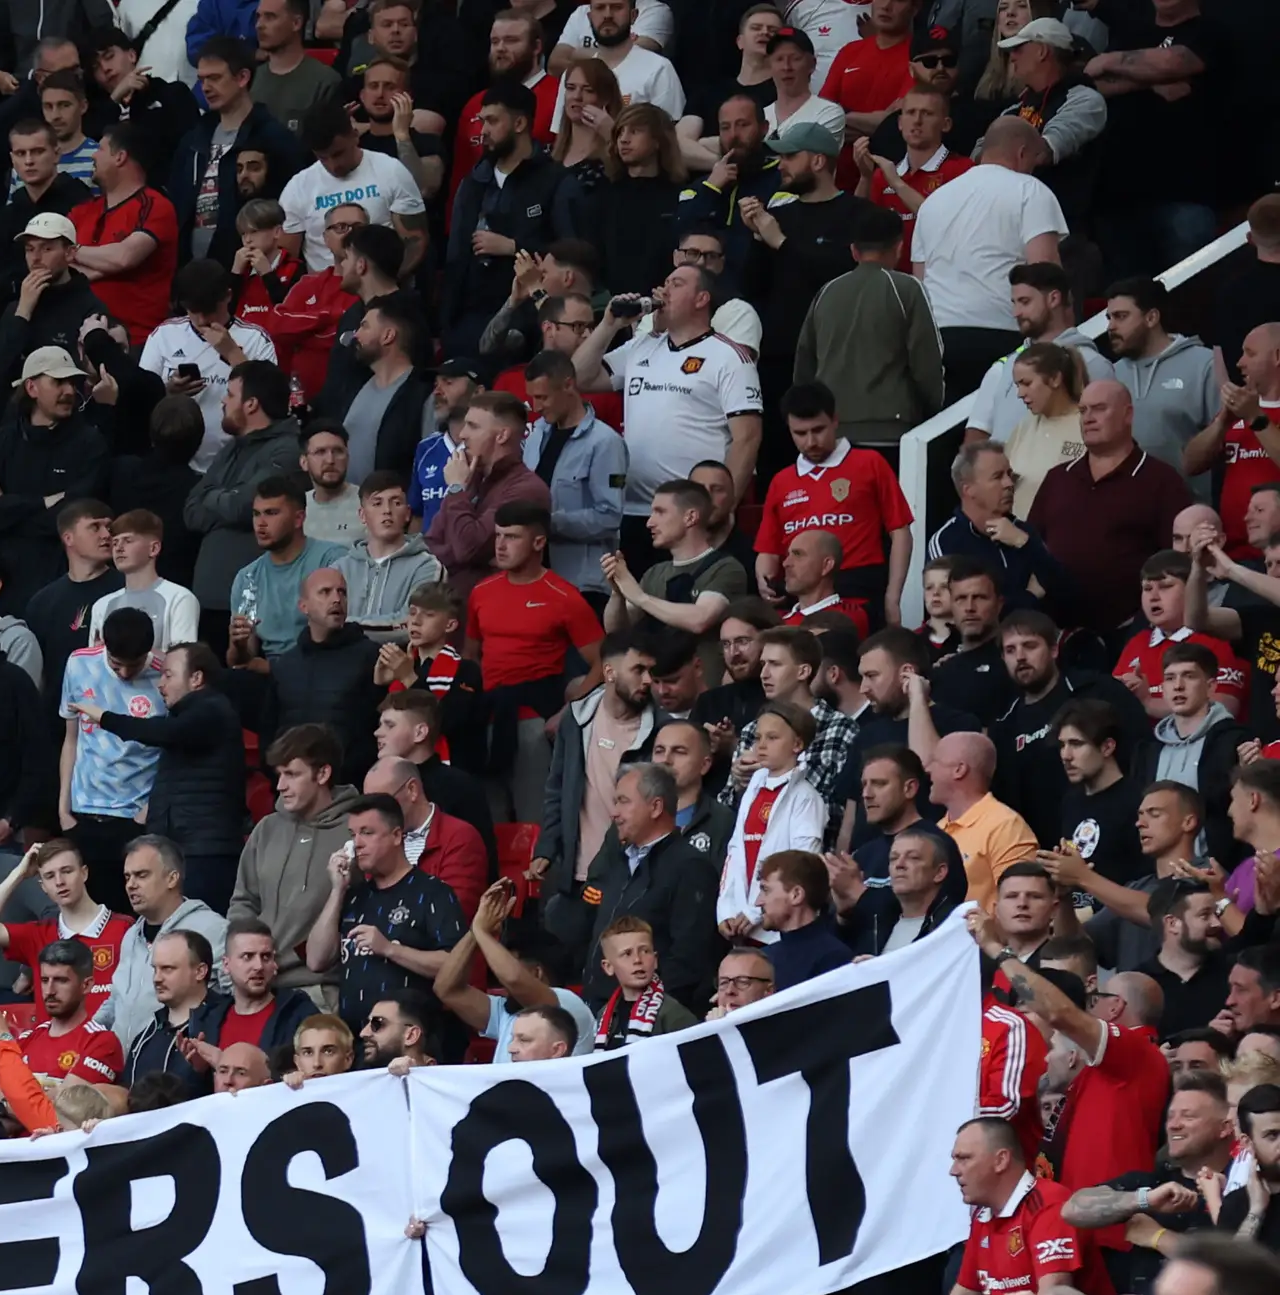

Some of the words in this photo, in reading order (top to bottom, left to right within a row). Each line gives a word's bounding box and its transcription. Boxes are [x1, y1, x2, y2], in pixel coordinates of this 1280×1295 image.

[315, 190, 343, 211] JUST
[344, 187, 364, 204] DO
[365, 184, 380, 199] IT.
[643, 382, 692, 395] TeamViewer
[746, 386, 762, 400] DX
[784, 513, 853, 535] SHARP
[1036, 1237, 1075, 1261] DXC
